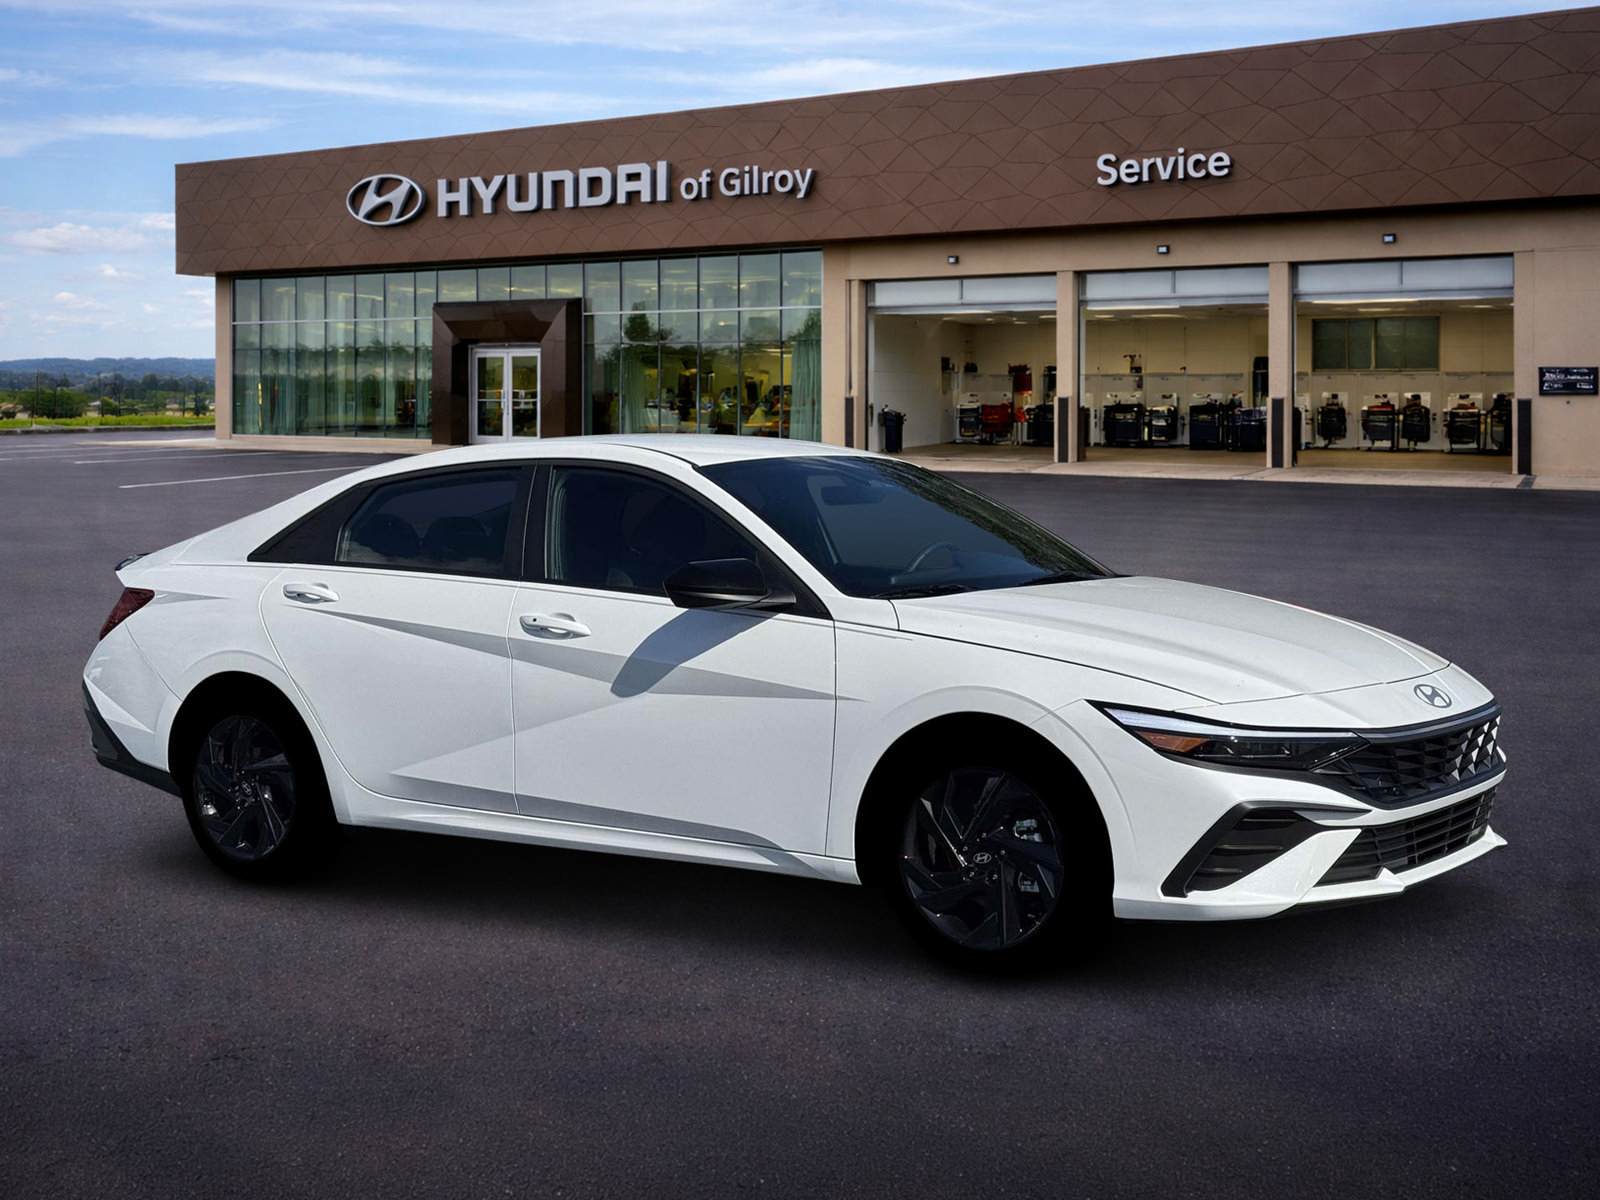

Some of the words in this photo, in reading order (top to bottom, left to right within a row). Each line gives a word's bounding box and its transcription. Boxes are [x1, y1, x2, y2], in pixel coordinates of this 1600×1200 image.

[437, 160, 667, 217] HYUNDAI
[680, 166, 711, 200] of
[719, 165, 813, 199] Gilroy
[1096, 147, 1231, 185] Service
